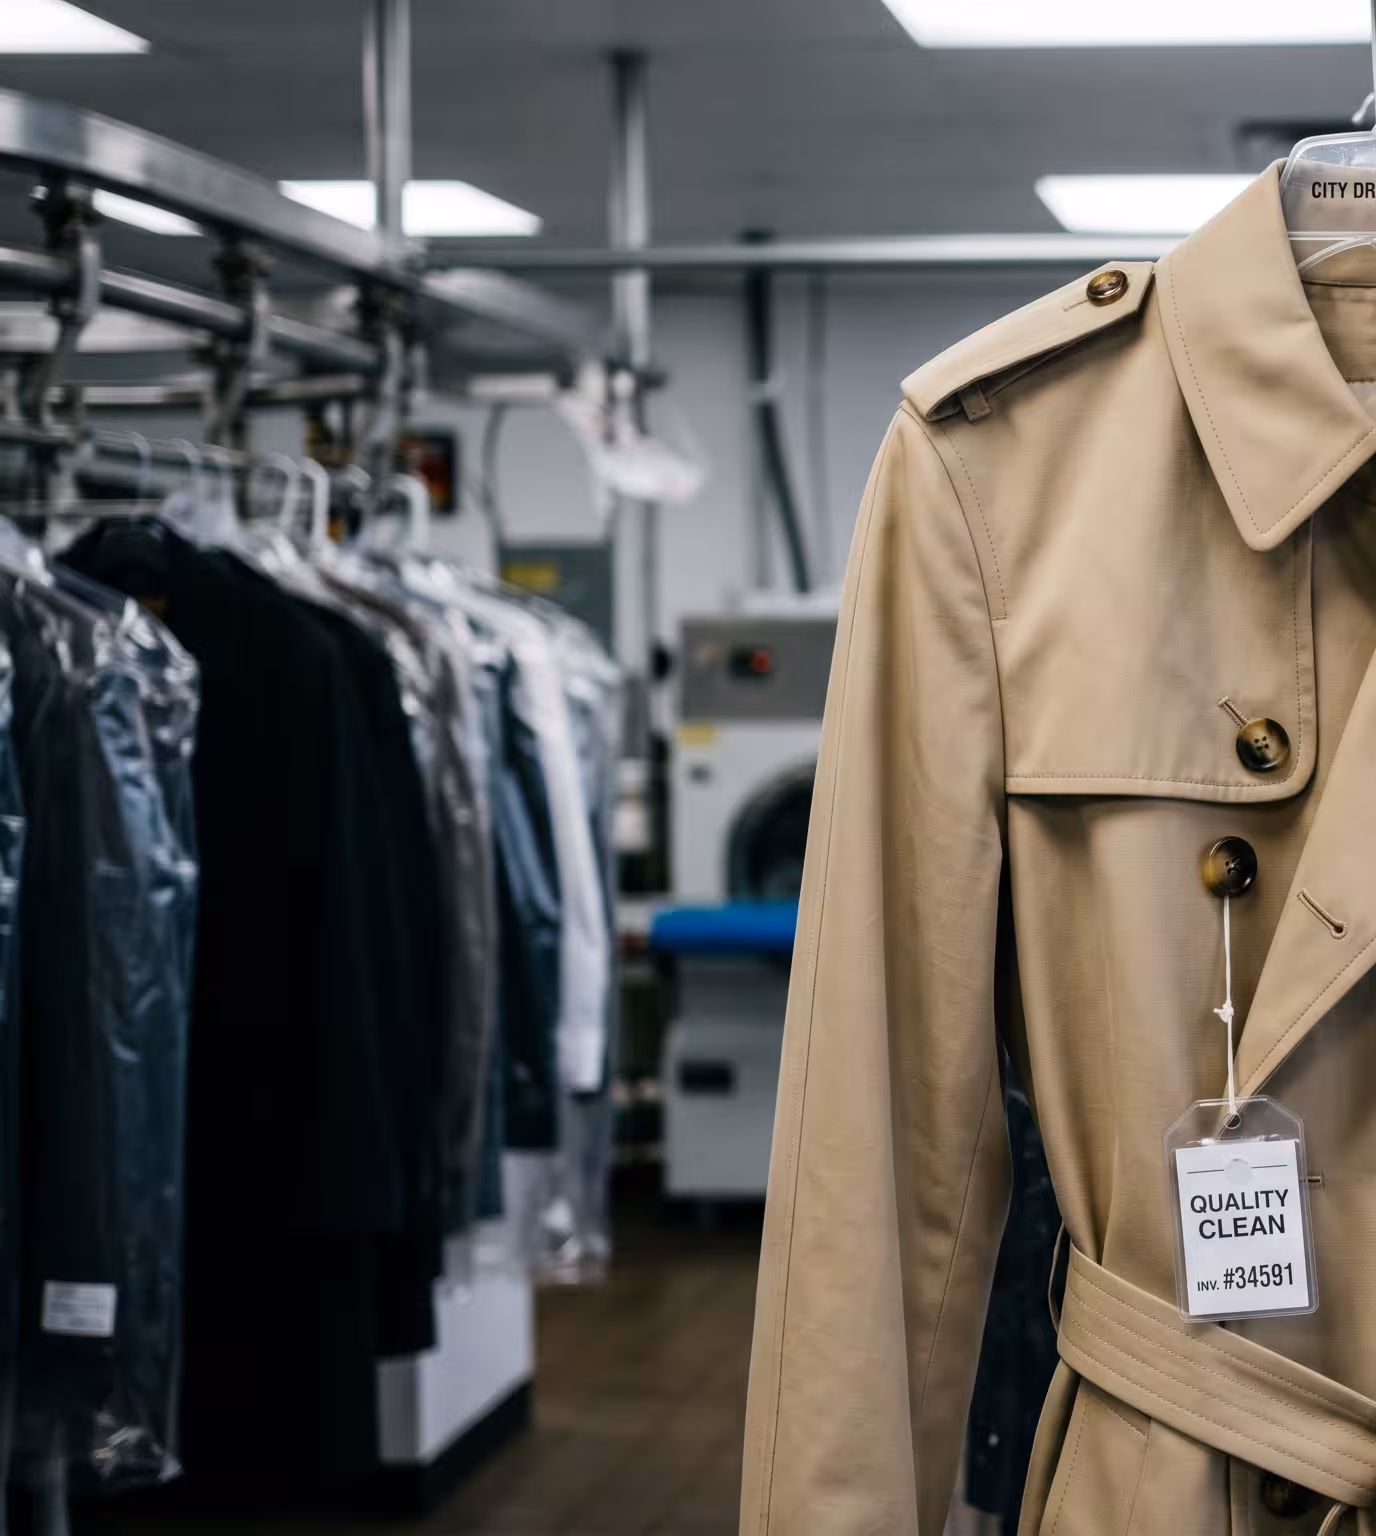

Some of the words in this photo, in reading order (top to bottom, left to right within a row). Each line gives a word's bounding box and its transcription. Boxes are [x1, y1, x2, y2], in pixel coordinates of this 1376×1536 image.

[1311, 181, 1349, 199] CITY
[1190, 1188, 1289, 1214] QUALITY
[1198, 1213, 1286, 1240] CLEAN
[1197, 1280, 1220, 1291] INV.
[1223, 1262, 1293, 1289] #34591
